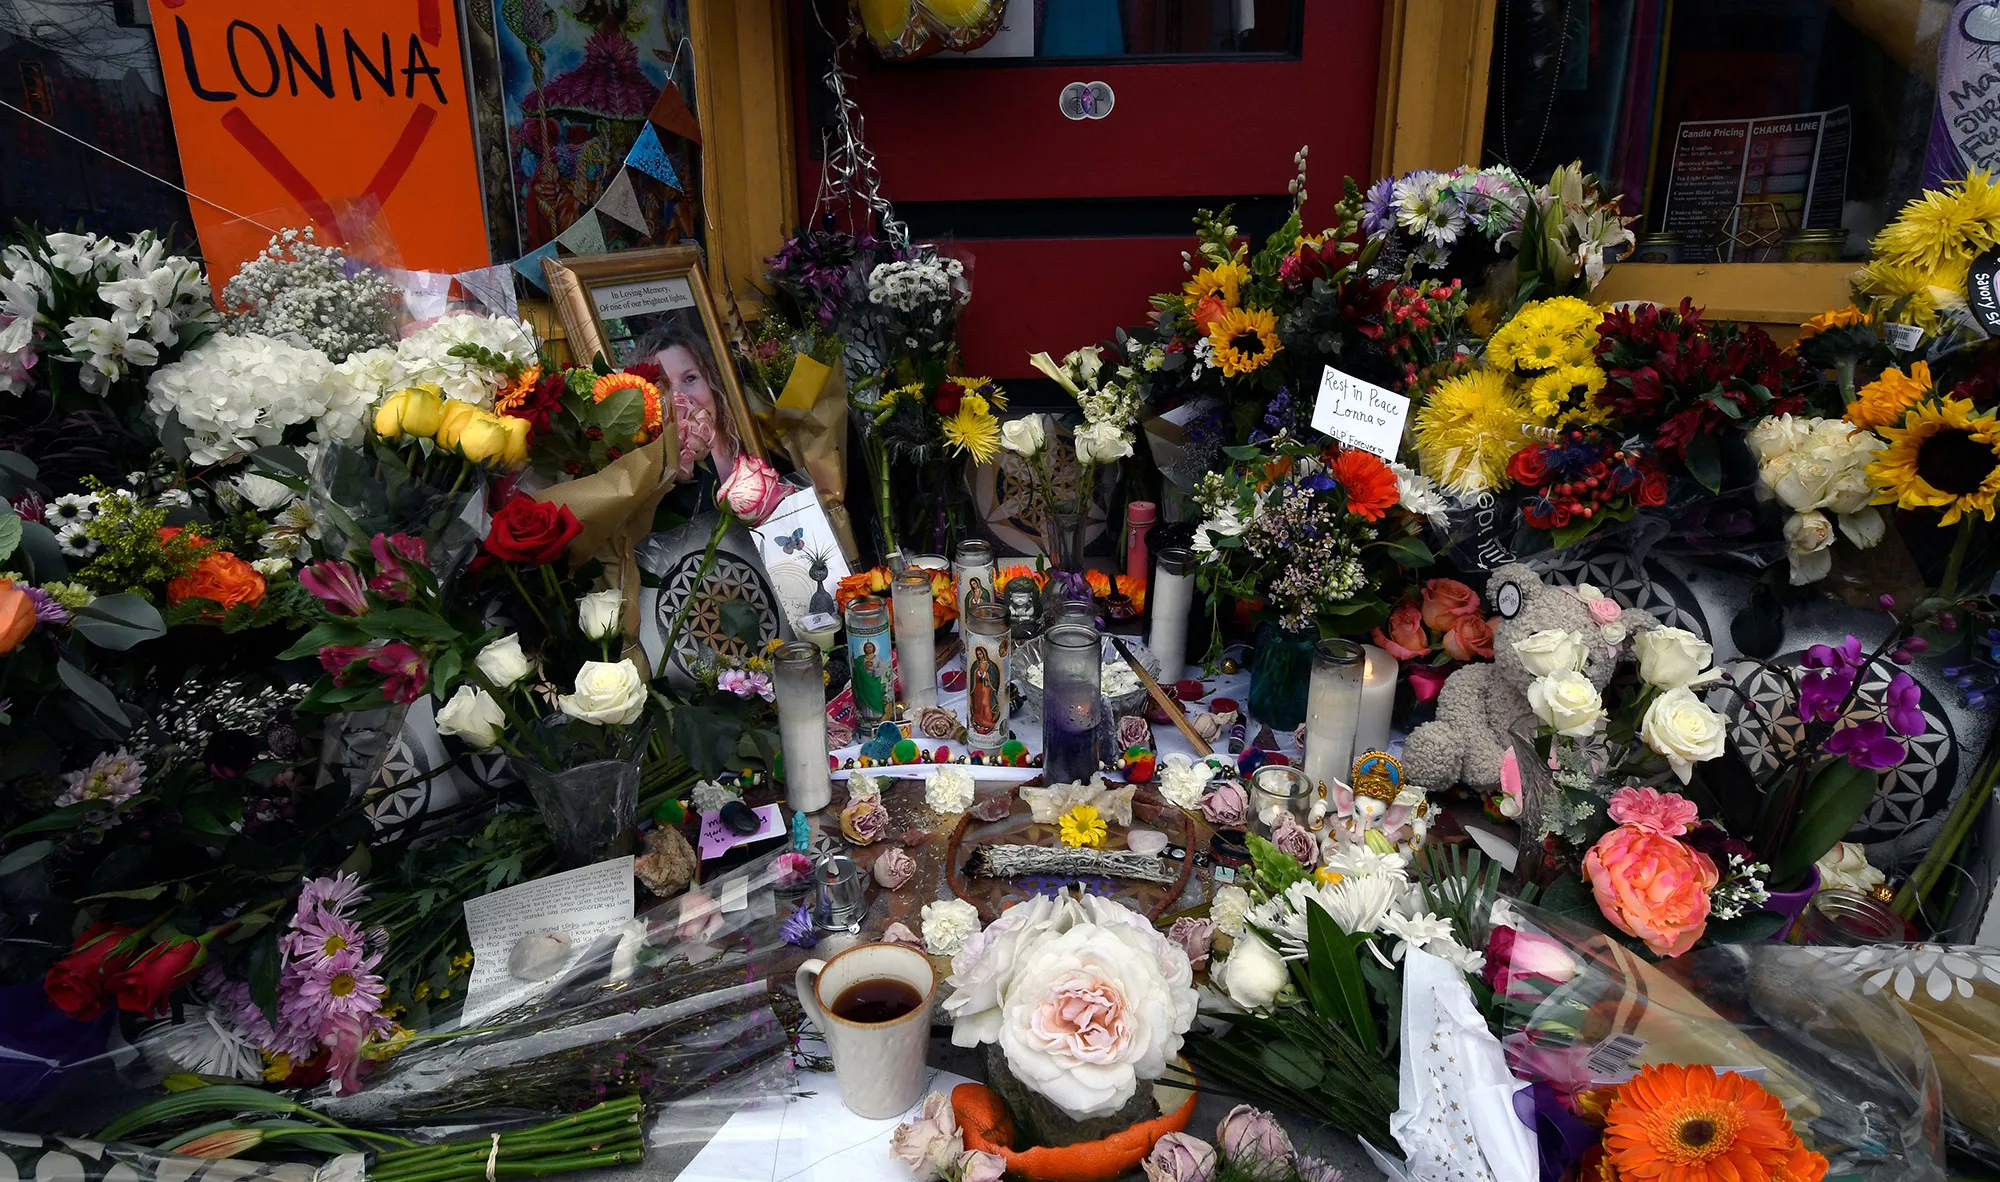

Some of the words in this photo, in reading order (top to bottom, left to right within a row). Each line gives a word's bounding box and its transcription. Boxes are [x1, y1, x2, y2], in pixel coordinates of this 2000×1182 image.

[175, 15, 448, 104] LONNA
[1682, 129, 1711, 138] Candle
[1714, 128, 1744, 138] Pricing
[1753, 123, 1792, 135] CHAKRA
[1795, 121, 1818, 131] LINE
[611, 291, 619, 300] In
[620, 289, 642, 298] Loving
[1975, 273, 1996, 309] Savory
[600, 304, 609, 312] Of
[623, 301, 631, 309] of
[643, 296, 669, 307] brightest
[1325, 370, 1348, 399] Rest
[1352, 384, 1362, 401] in
[1369, 388, 1399, 415] Peace
[1332, 399, 1374, 424] Lonna
[1329, 426, 1347, 440] GLP
[1349, 435, 1379, 453] Forever
